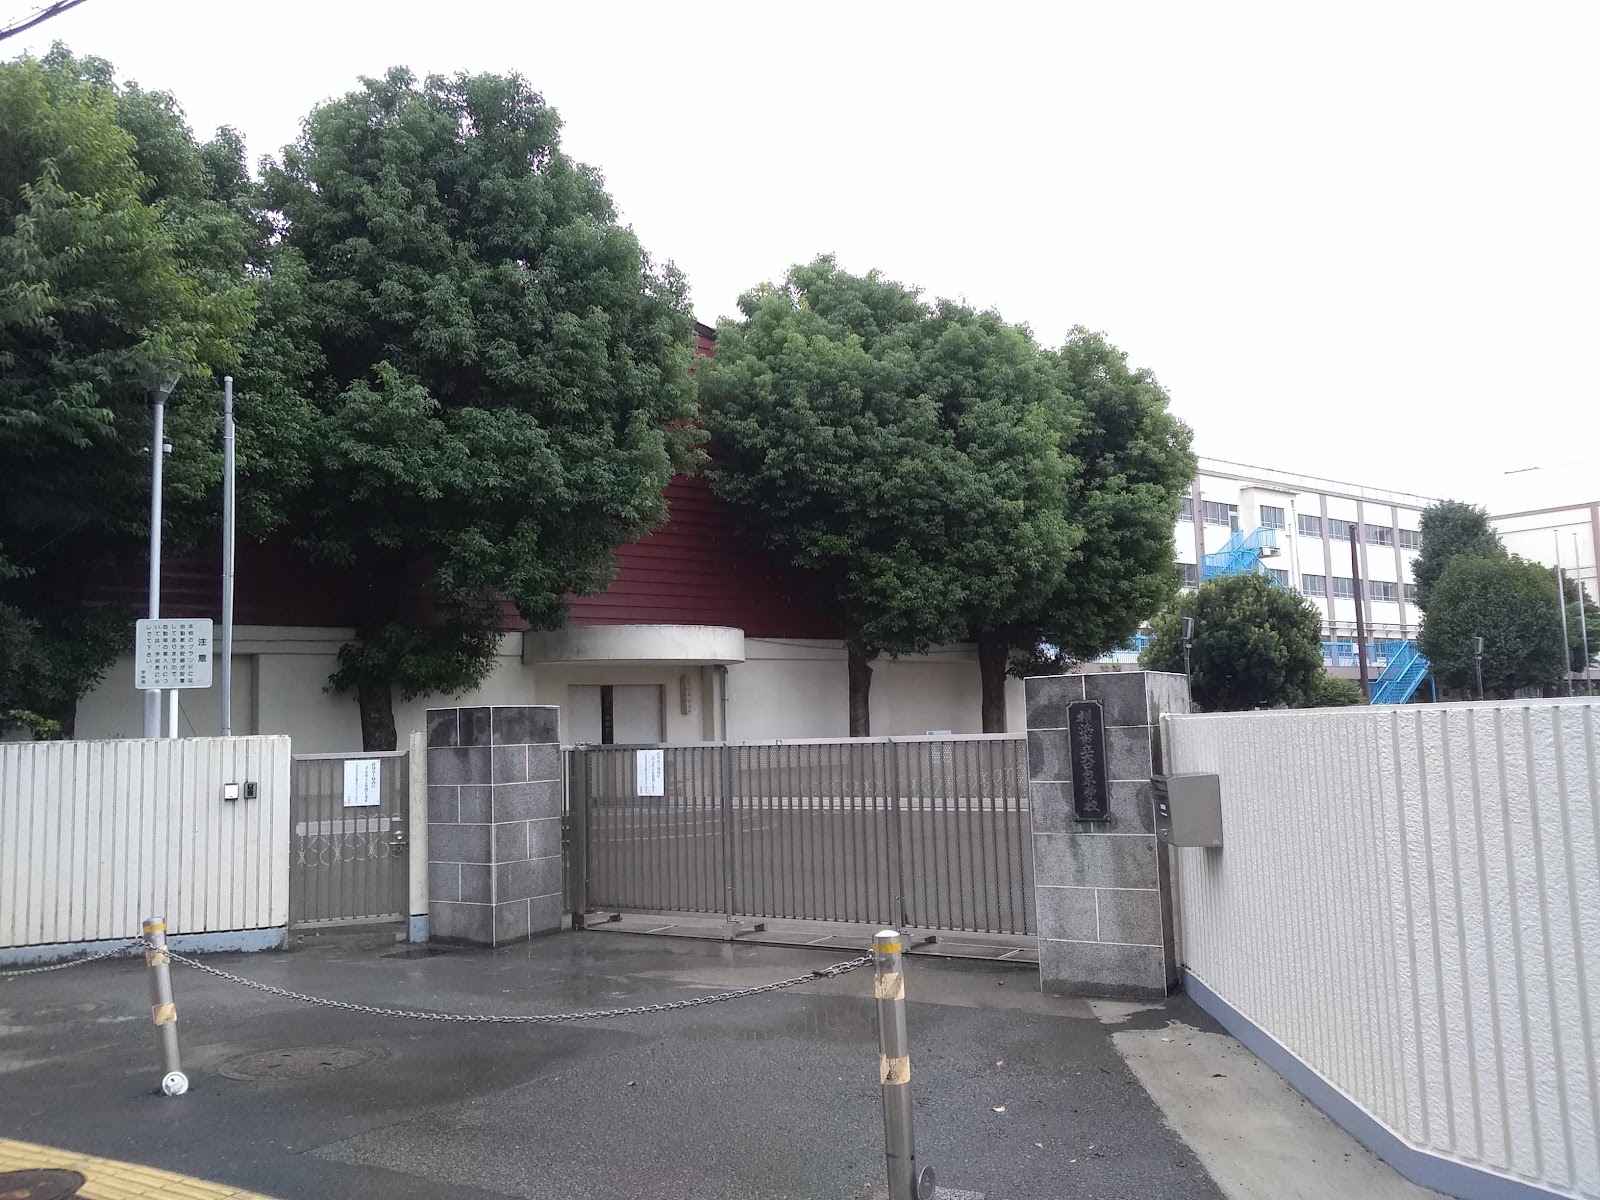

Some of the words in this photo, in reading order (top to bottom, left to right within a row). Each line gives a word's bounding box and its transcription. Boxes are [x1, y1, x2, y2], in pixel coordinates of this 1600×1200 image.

[197, 638, 207, 663] 注意
[1075, 709, 1102, 812] 横浜市立大口台小学校
